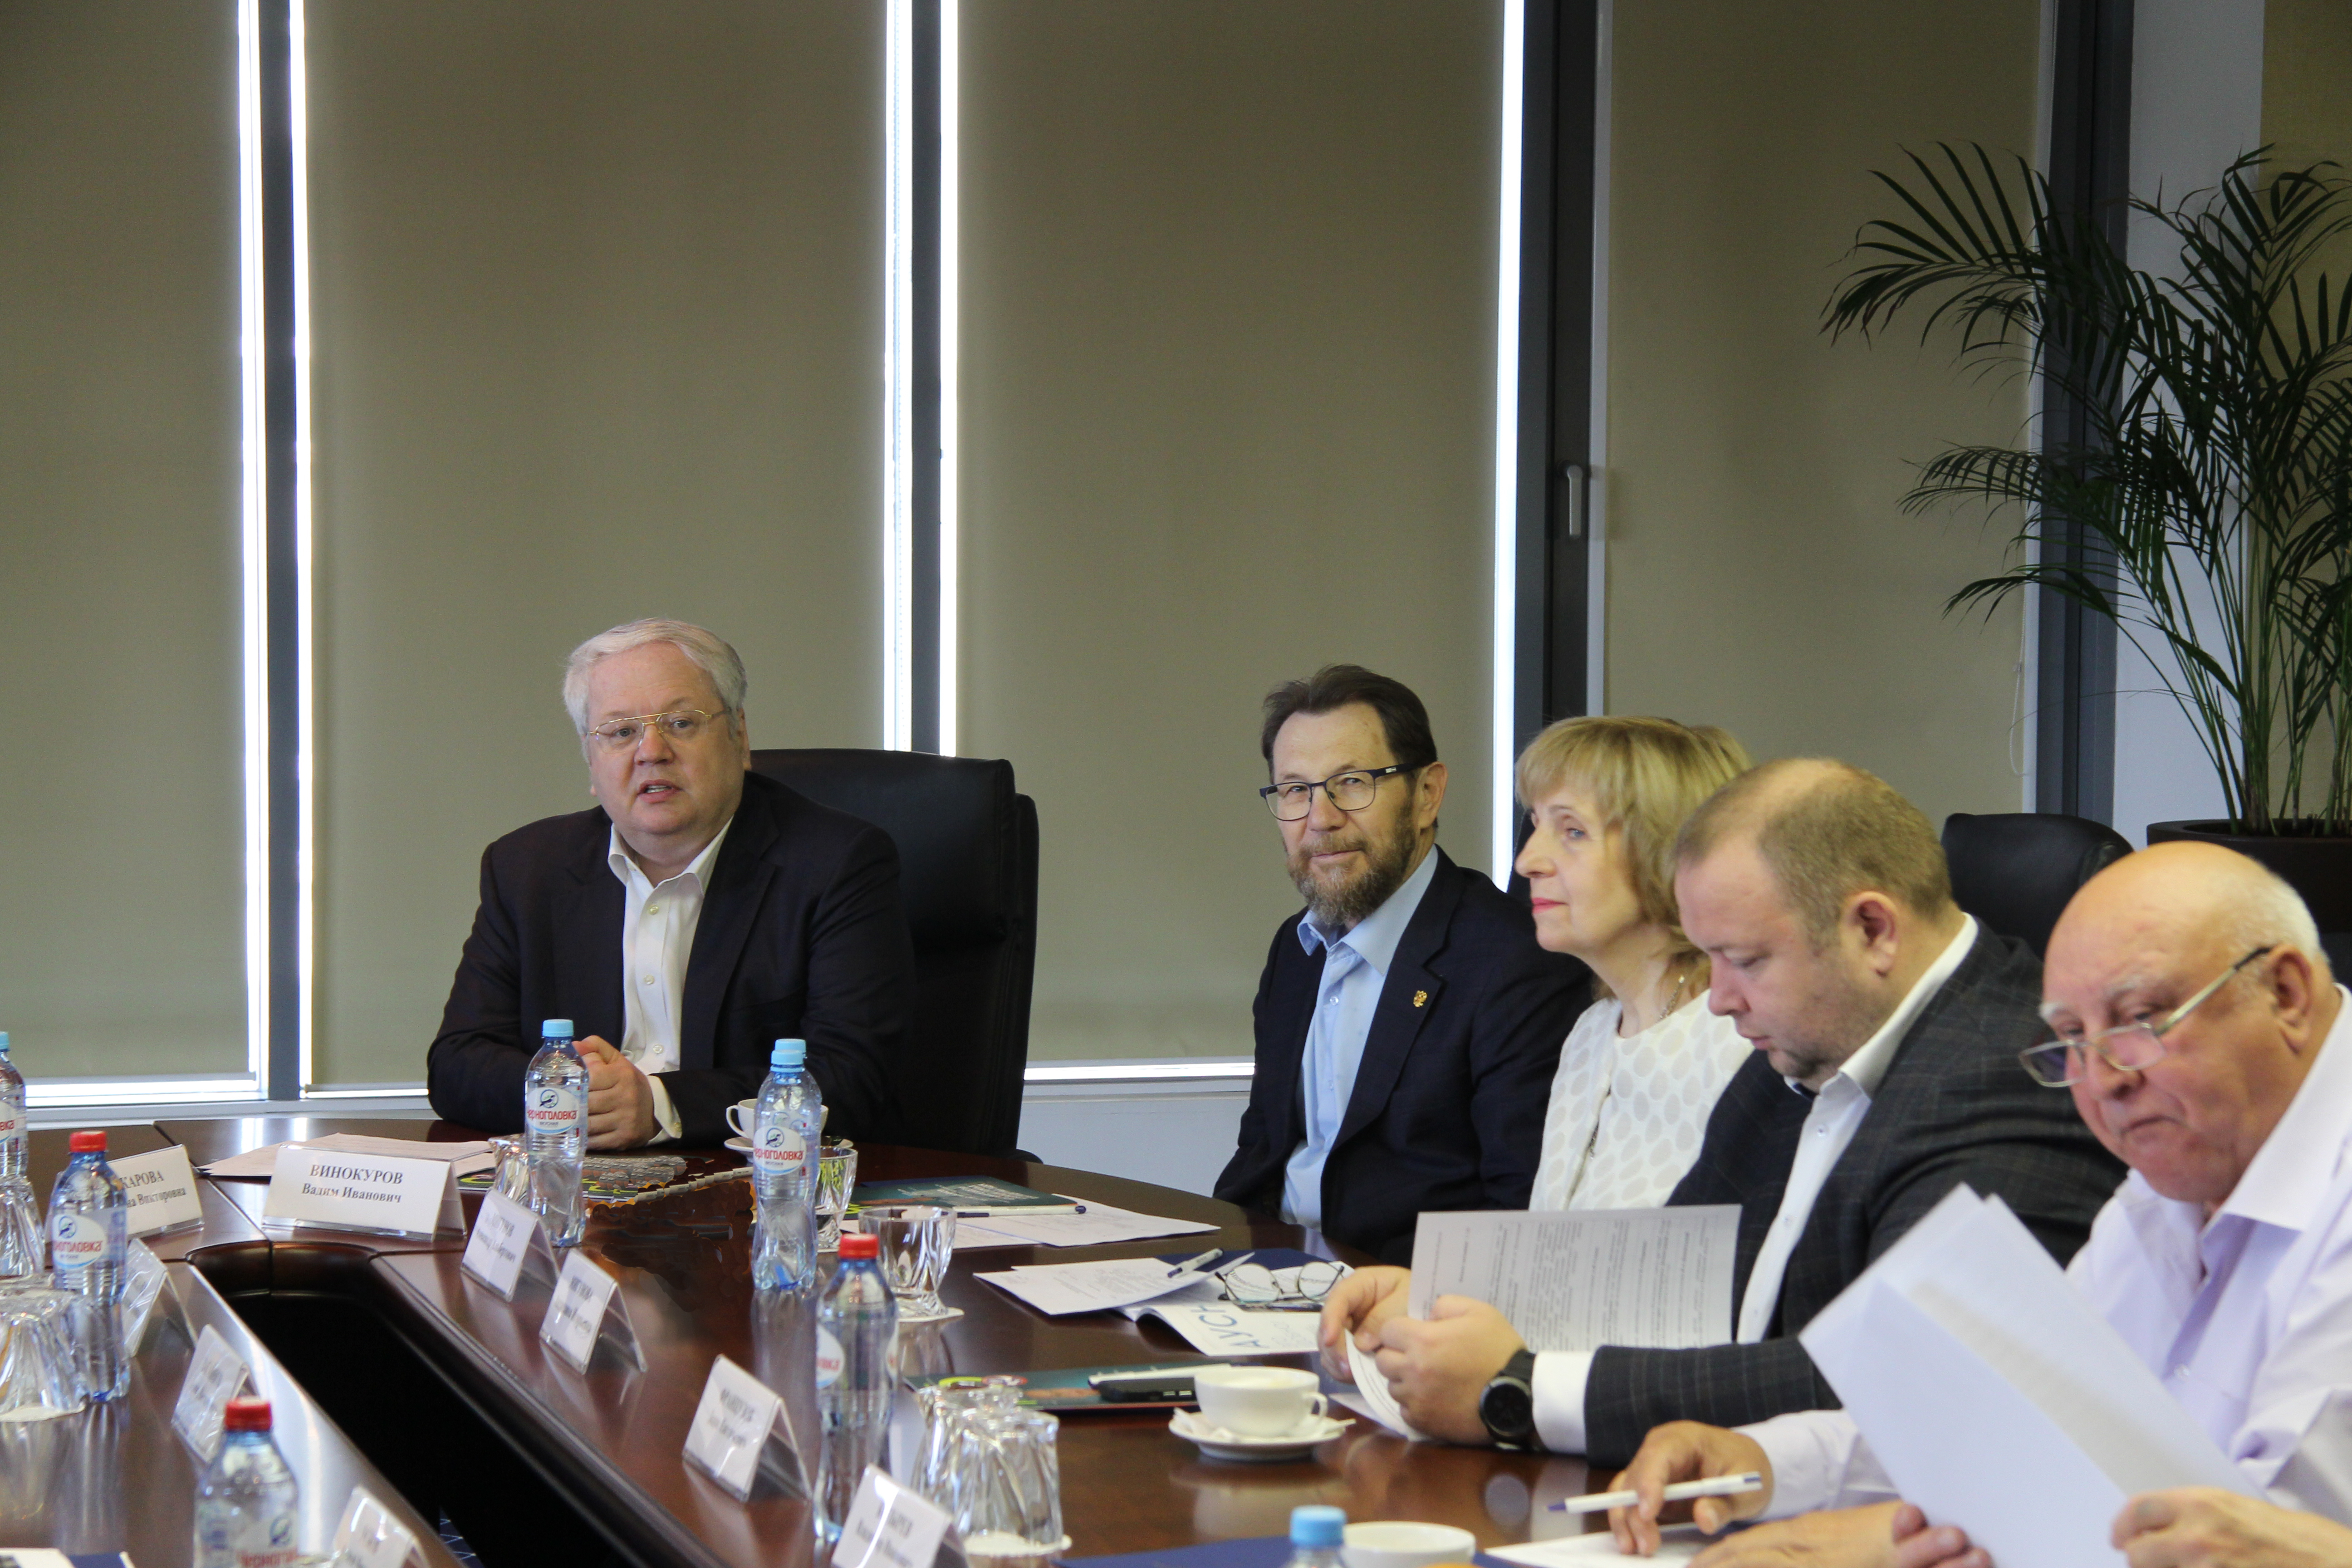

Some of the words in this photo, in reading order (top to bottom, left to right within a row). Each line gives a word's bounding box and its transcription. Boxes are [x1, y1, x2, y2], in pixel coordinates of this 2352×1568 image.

[119, 1170, 164, 1189] КАРОВА
[309, 1164, 403, 1184] ВИНОКУРОВ
[302, 1182, 339, 1197] Вадим
[341, 1186, 402, 1204] Иванович
